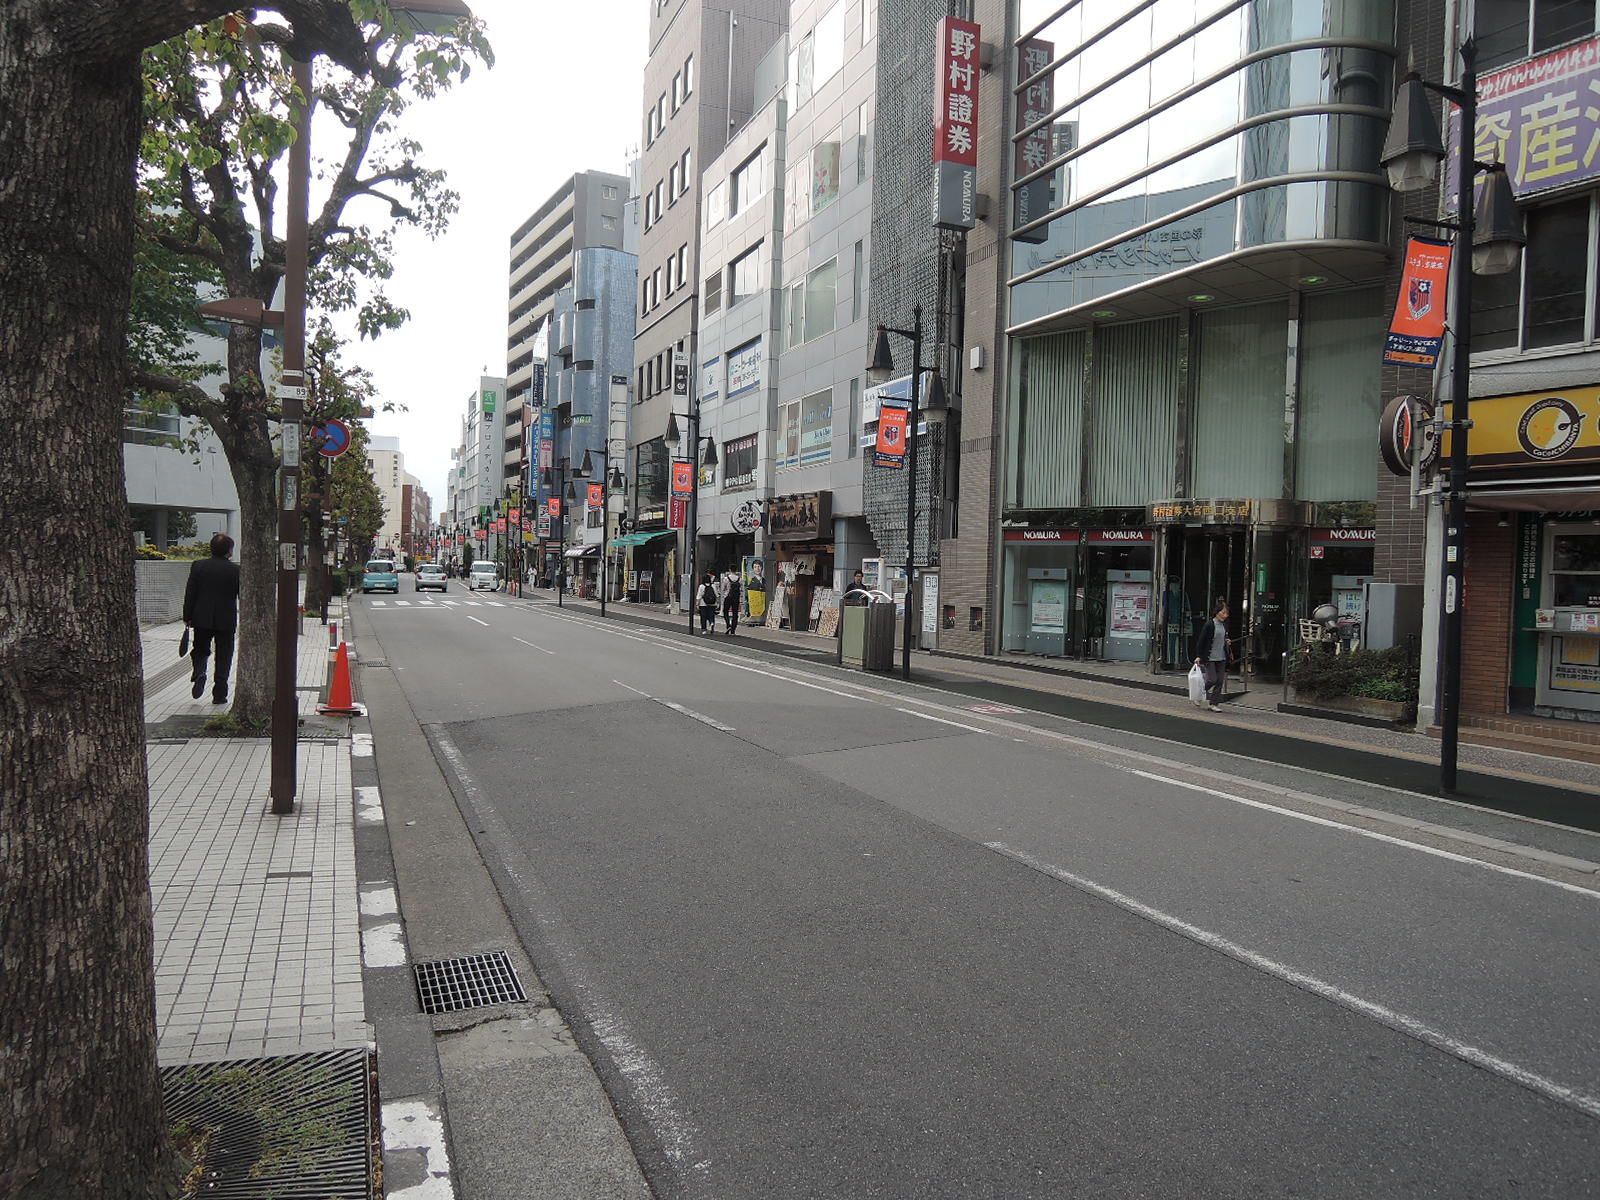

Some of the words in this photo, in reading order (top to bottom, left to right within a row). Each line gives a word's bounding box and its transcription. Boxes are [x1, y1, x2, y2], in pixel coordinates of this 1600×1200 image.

[948, 29, 977, 154] 野村證券
[962, 170, 972, 223] NOMURA
[1023, 530, 1061, 540] NOMURA
[1102, 530, 1144, 540] NOMURA
[1329, 529, 1377, 541] NOMUR
